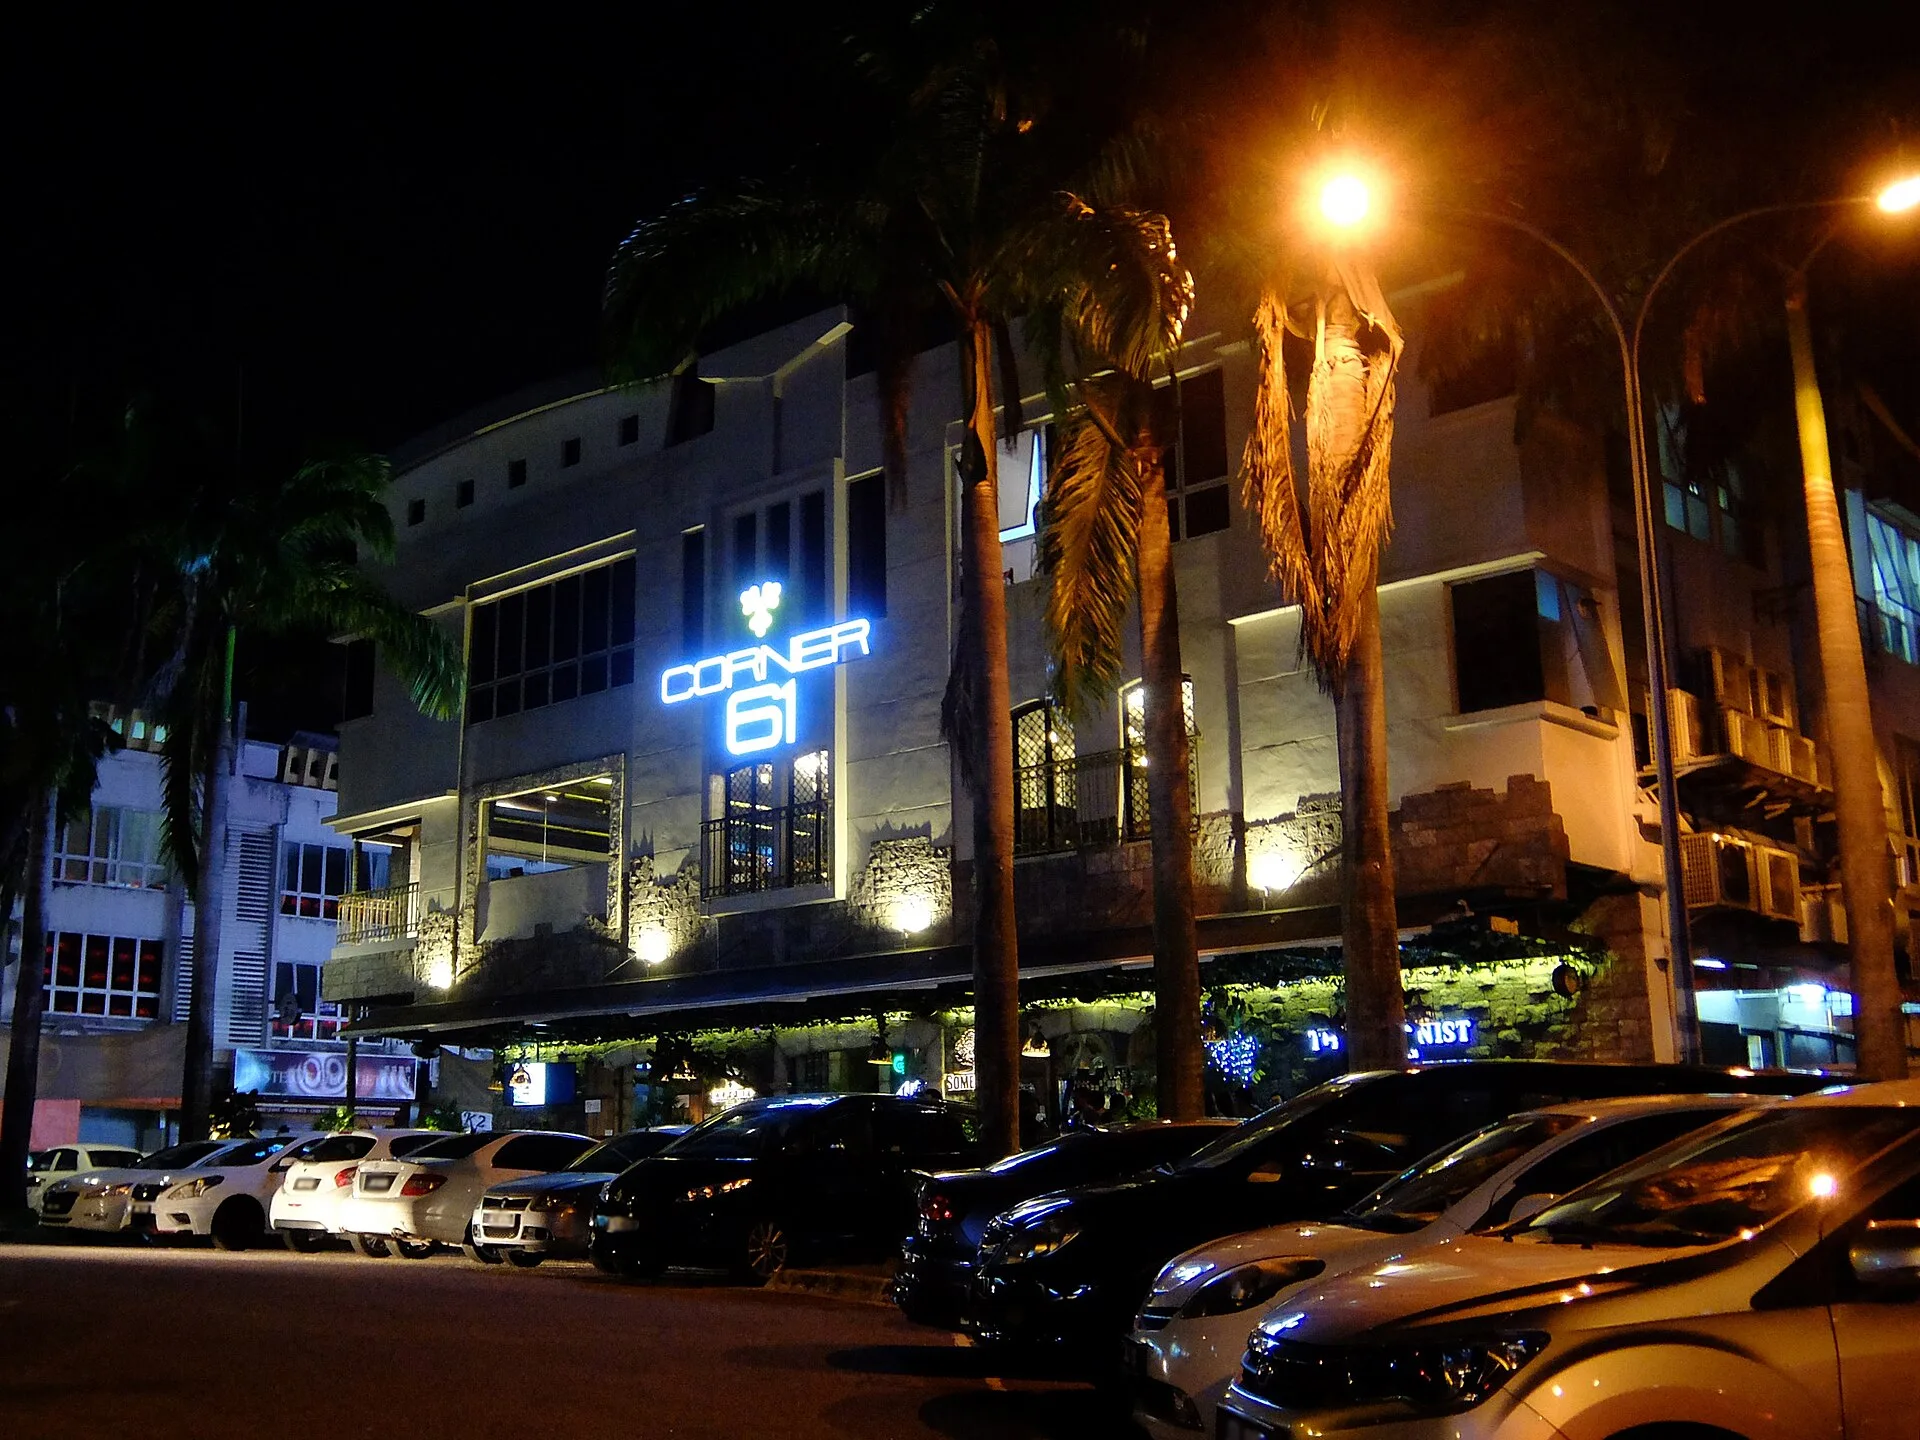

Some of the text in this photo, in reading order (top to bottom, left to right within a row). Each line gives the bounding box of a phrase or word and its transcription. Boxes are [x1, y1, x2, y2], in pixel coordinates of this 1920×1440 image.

[661, 618, 871, 705] CORNER
[726, 678, 797, 755] 61
[1404, 1018, 1472, 1046] NIST
[946, 1075, 975, 1091] SOME
